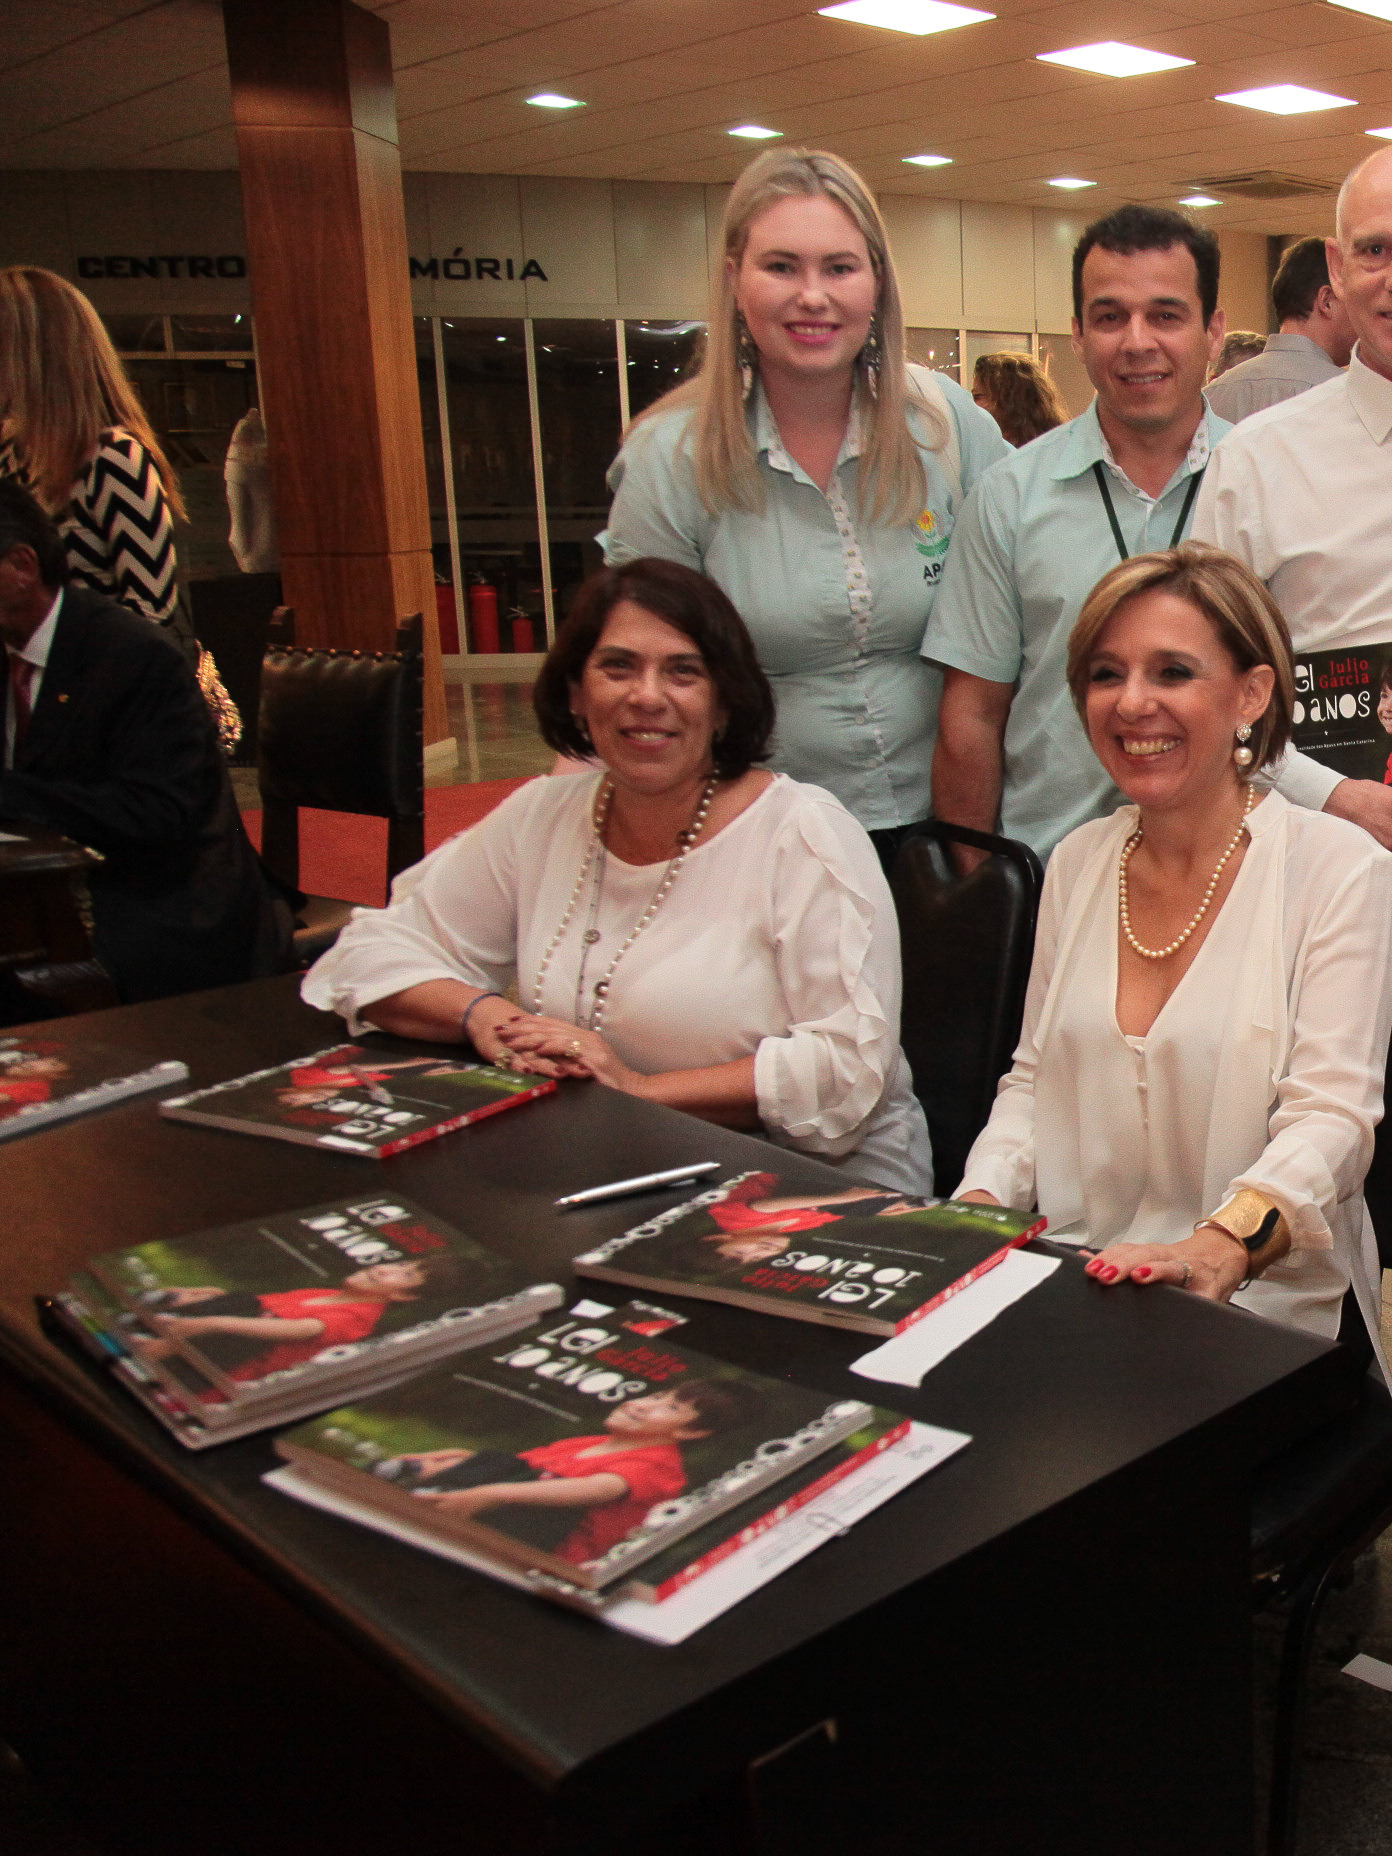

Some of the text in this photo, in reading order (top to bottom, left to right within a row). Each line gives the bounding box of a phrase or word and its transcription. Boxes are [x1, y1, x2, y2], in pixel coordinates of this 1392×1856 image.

[77, 247, 549, 282] CENTRO MÓRIA
[923, 562, 942, 580] AP
[1329, 657, 1369, 676] Julio
[1319, 671, 1371, 689] Garcia
[1310, 691, 1370, 722] aNOS
